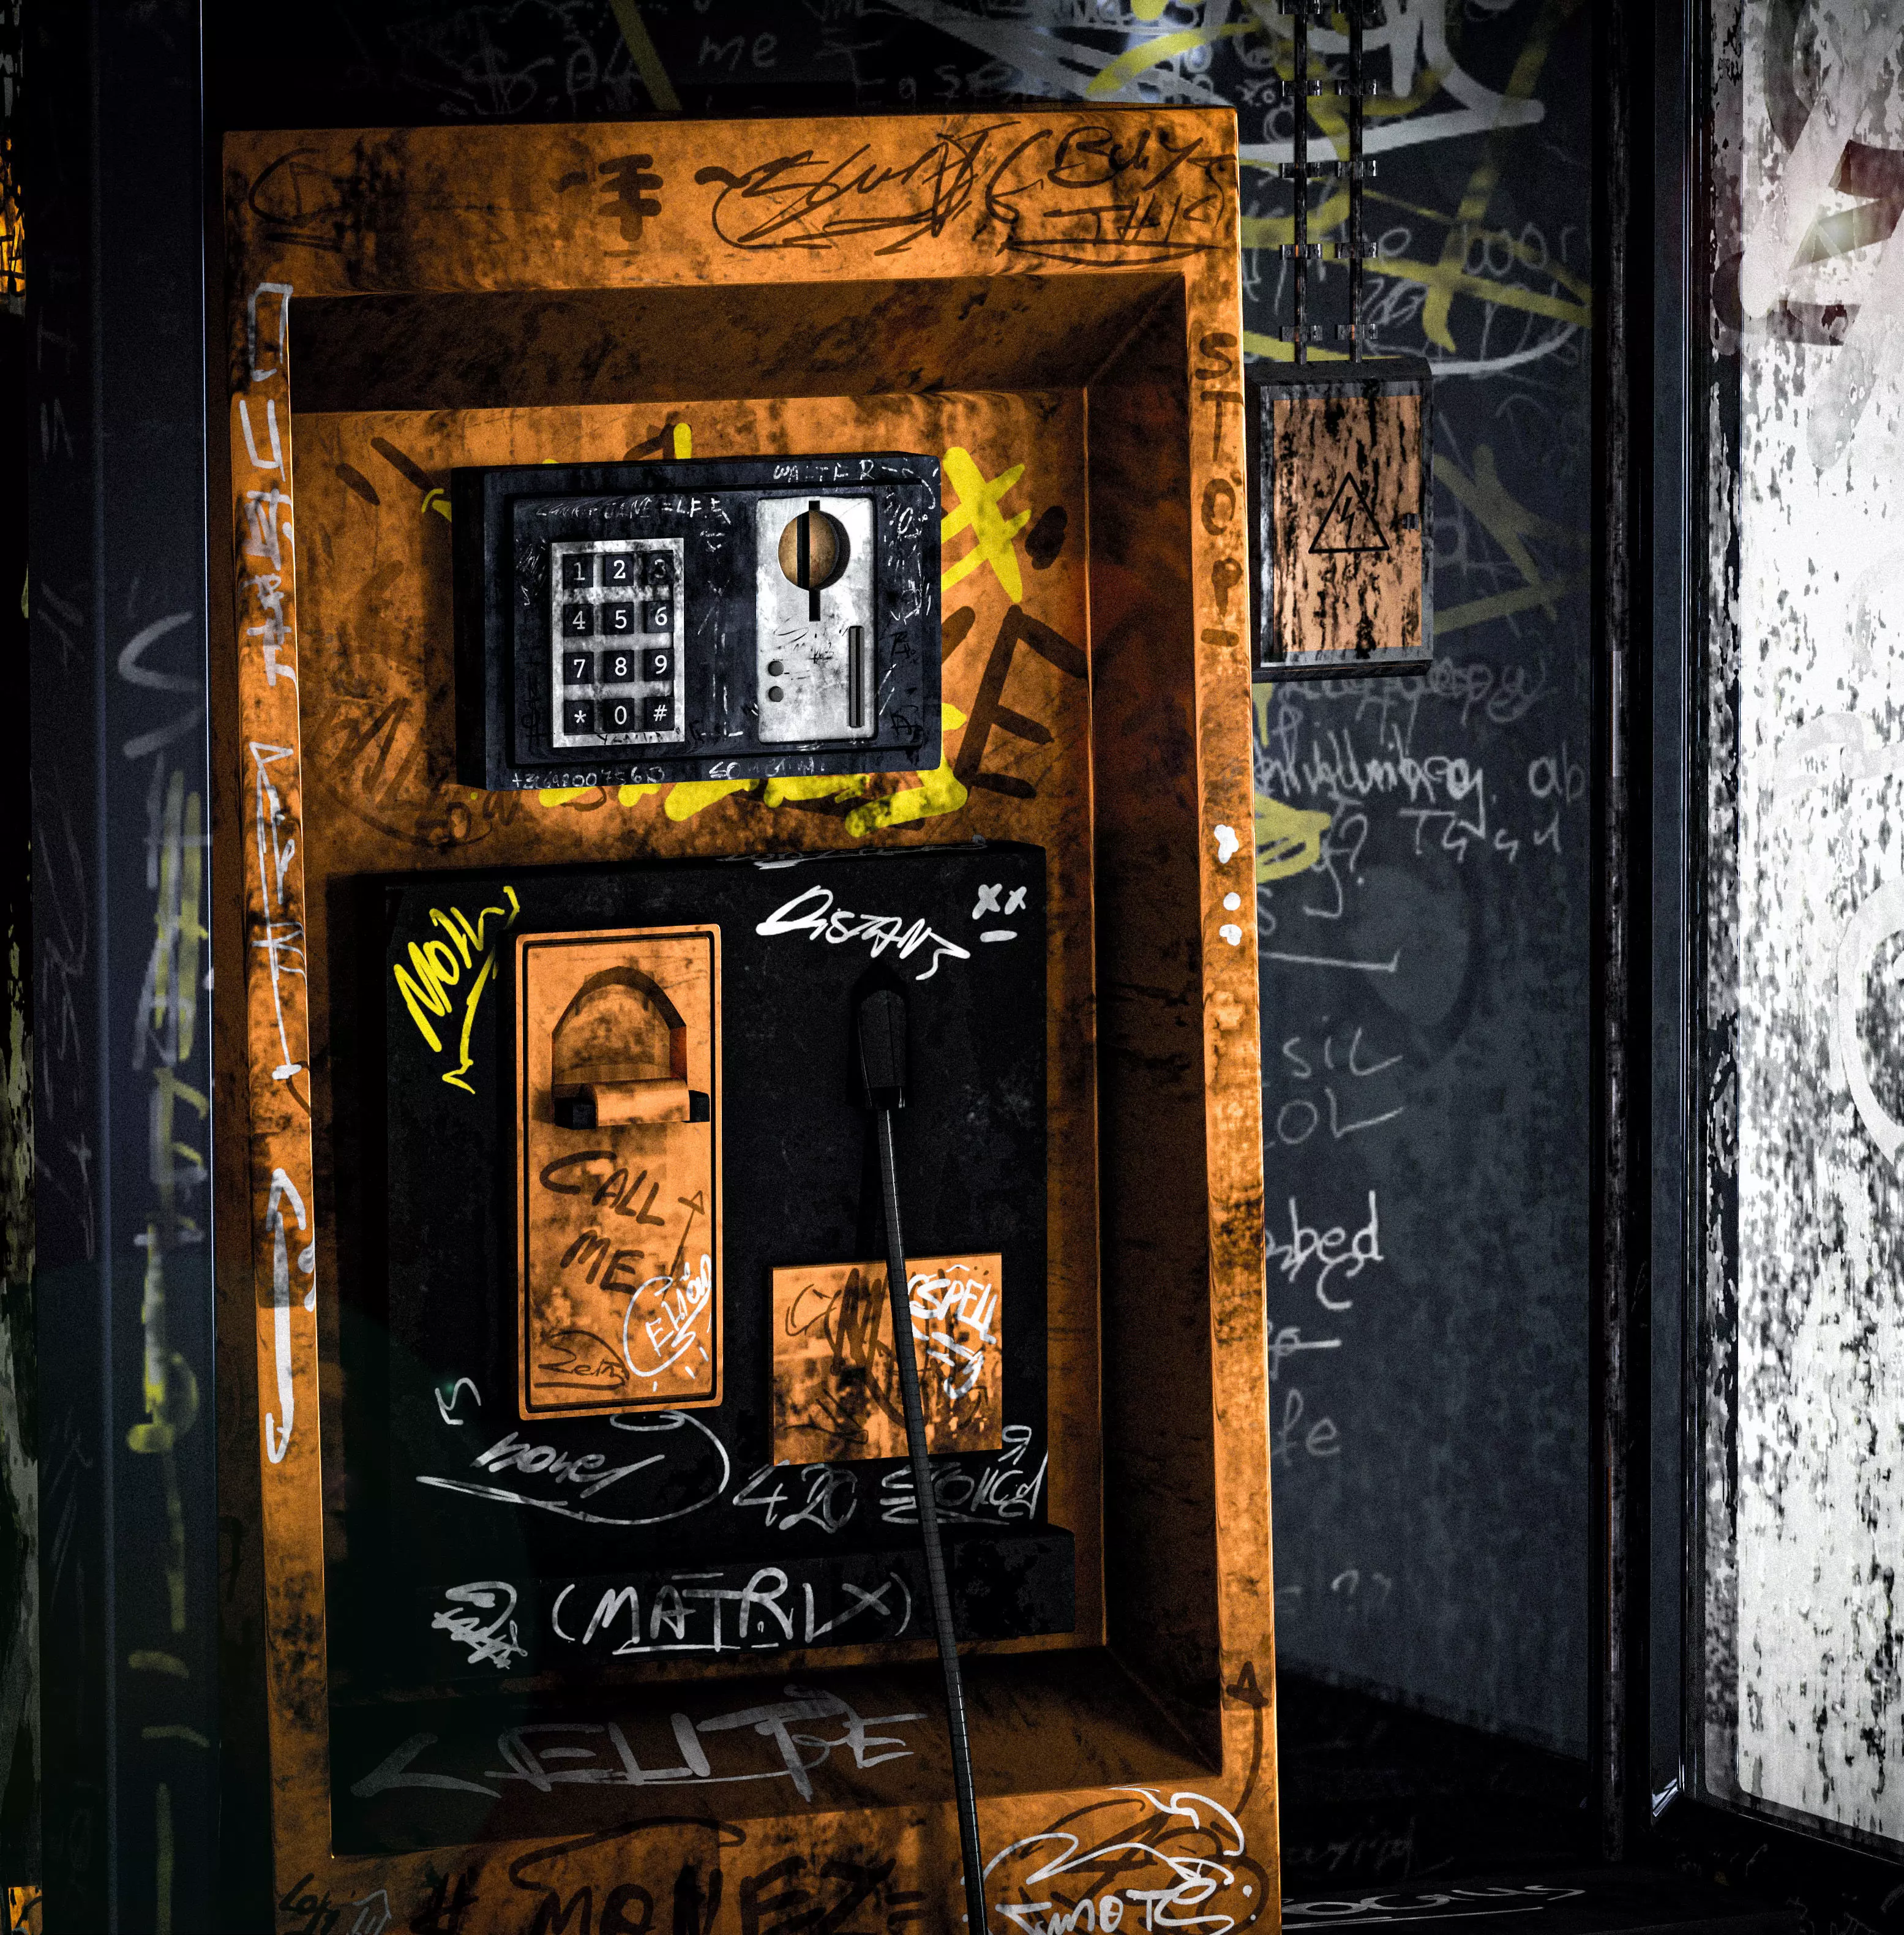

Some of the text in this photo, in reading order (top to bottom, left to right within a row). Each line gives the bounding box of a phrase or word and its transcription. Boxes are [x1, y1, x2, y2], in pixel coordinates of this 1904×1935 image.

[574, 558, 666, 580] 1 2 3
[572, 606, 667, 630] 4 5 6
[574, 655, 667, 678] 7 8 9
[614, 705, 627, 724] 0
[540, 1149, 665, 1227] CALL
[560, 1229, 645, 1296] ME
